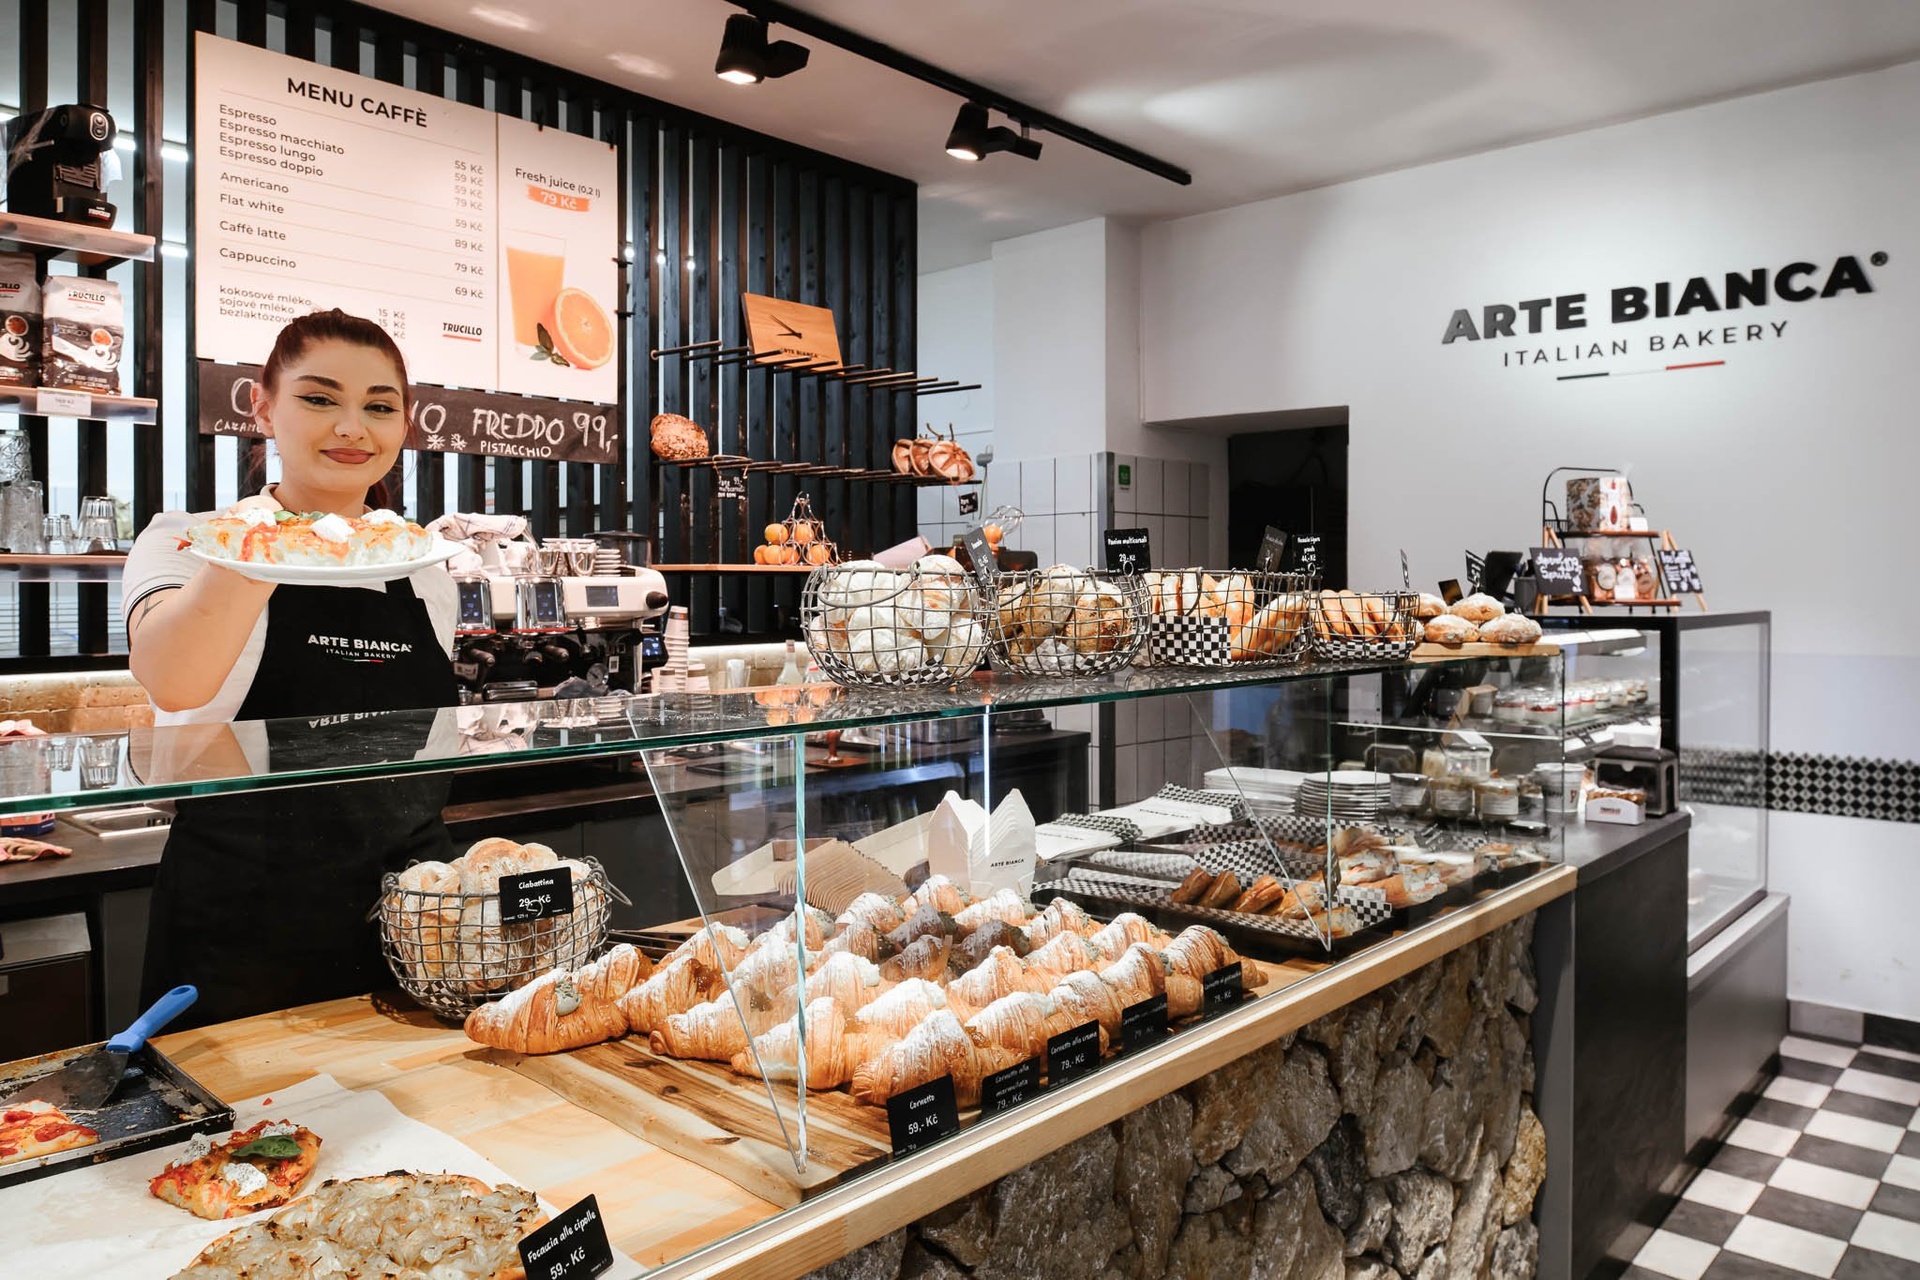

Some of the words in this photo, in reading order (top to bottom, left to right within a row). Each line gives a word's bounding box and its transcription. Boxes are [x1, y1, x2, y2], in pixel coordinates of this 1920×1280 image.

[287, 77, 354, 108] MENU
[360, 98, 427, 128] CAFFÈ
[219, 104, 277, 126] Espresso
[219, 118, 277, 139] Espresso
[280, 133, 345, 155] macchiato
[219, 132, 277, 153] Espresso
[280, 145, 316, 162] lungo
[219, 146, 277, 166] Espresso
[280, 160, 324, 176] doppio
[454, 160, 467, 171] 55
[470, 163, 484, 175] Kč
[220, 172, 289, 193] Americano
[454, 172, 467, 183] 59
[515, 168, 546, 184] Fresh
[549, 175, 576, 191] juice
[578, 185, 593, 196] (0,2
[454, 185, 467, 195] 59
[220, 193, 244, 206] Flat
[248, 200, 285, 214] white
[454, 197, 467, 207] 79
[540, 191, 557, 205] 79
[560, 195, 578, 210] Kč
[219, 220, 254, 235] Caffè
[257, 227, 286, 241] latte
[455, 218, 467, 229] 59
[455, 239, 468, 249] 89
[470, 241, 484, 252] Kč
[219, 247, 297, 269] Cappuccino
[454, 262, 468, 273] 79
[470, 265, 484, 276] Kč
[219, 285, 274, 301] kokosové
[278, 294, 312, 306] mléko
[455, 286, 468, 296] 69
[470, 288, 484, 299] Kč
[219, 297, 256, 309] sojové
[260, 303, 295, 314] mléko
[1441, 293, 1588, 344] ARTE
[442, 322, 483, 336] TRUCILLO
[1504, 339, 1628, 367] ITALIAN
[1649, 320, 1790, 352] BAKERY
[472, 407, 565, 445] FREDDO
[480, 440, 552, 458] PISTACCHIO
[308, 634, 349, 648] ARTE
[326, 648, 360, 657] ITALIAN
[518, 878, 554, 890] Ciabattina
[538, 894, 551, 904] Kč
[909, 1094, 935, 1109] Cornetto
[908, 1121, 924, 1135] 59,-
[925, 1113, 938, 1127] Kč
[527, 1236, 559, 1264] Focaccia
[559, 1225, 574, 1241] alle
[574, 1210, 596, 1232] cipolle
[550, 1260, 570, 1280] 59,-
[570, 1246, 586, 1267] Kč
